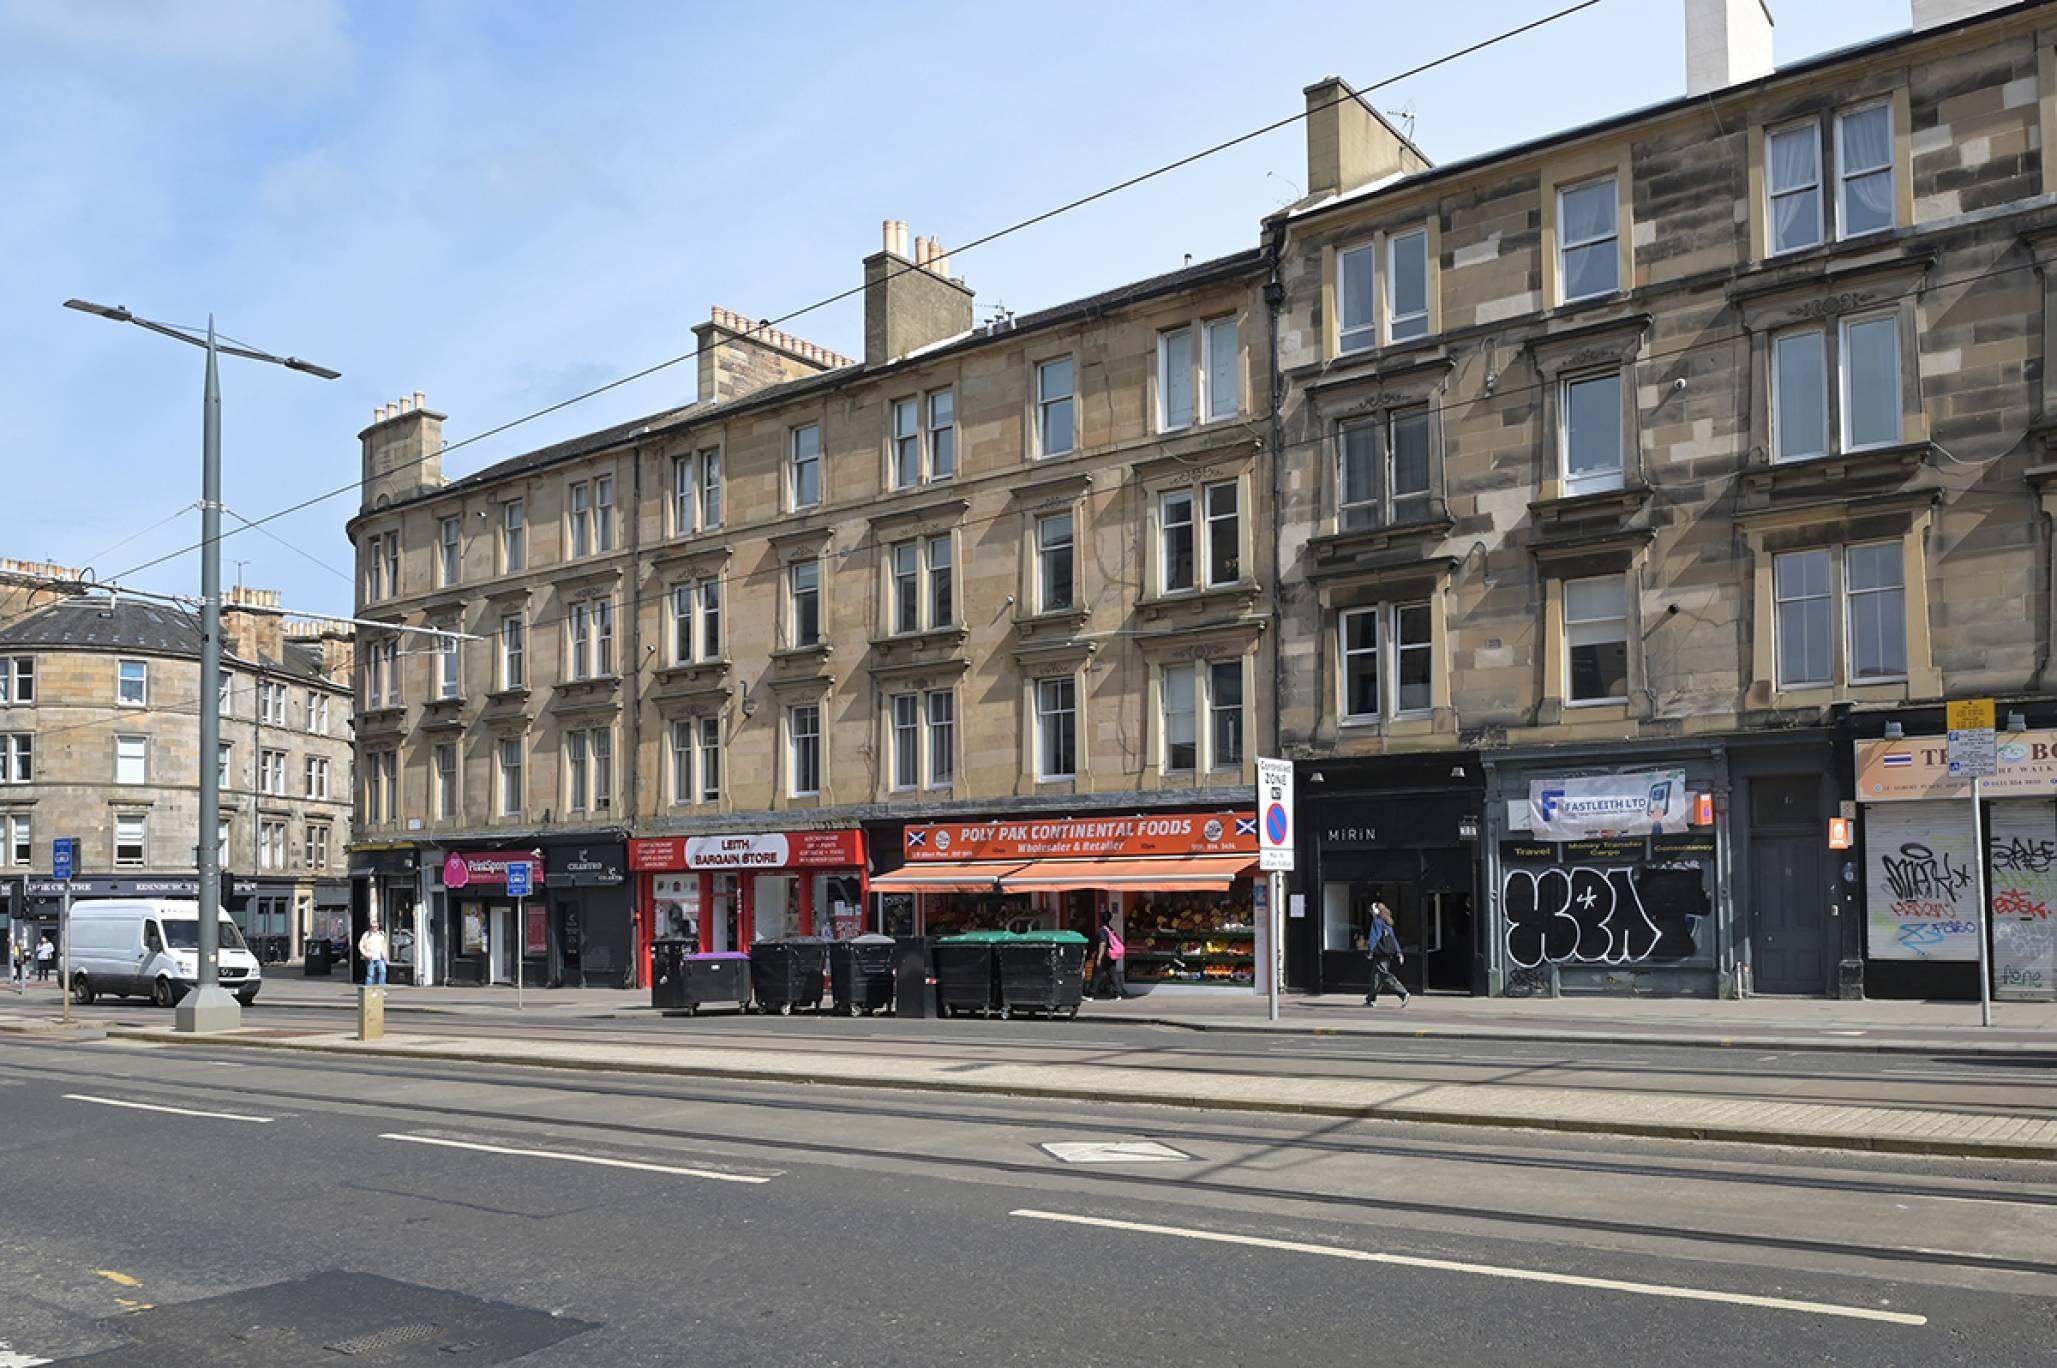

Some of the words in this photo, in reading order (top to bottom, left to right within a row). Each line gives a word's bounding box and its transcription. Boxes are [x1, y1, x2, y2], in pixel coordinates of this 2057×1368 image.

[1624, 798, 1646, 808] LTD
[960, 827, 995, 842] POLY
[998, 825, 1027, 841] PAK
[1031, 821, 1134, 840] CONTINENTAL
[1137, 819, 1192, 836] FOODS
[1327, 828, 1376, 841] MIRIN
[721, 839, 750, 850] LEITH
[1018, 842, 1071, 853] Wholesaler
[1073, 841, 1081, 851] &
[1083, 840, 1126, 851] Retailer
[695, 853, 740, 865] BARGAIN
[742, 851, 777, 864] STORE
[1515, 847, 1551, 856] Travel
